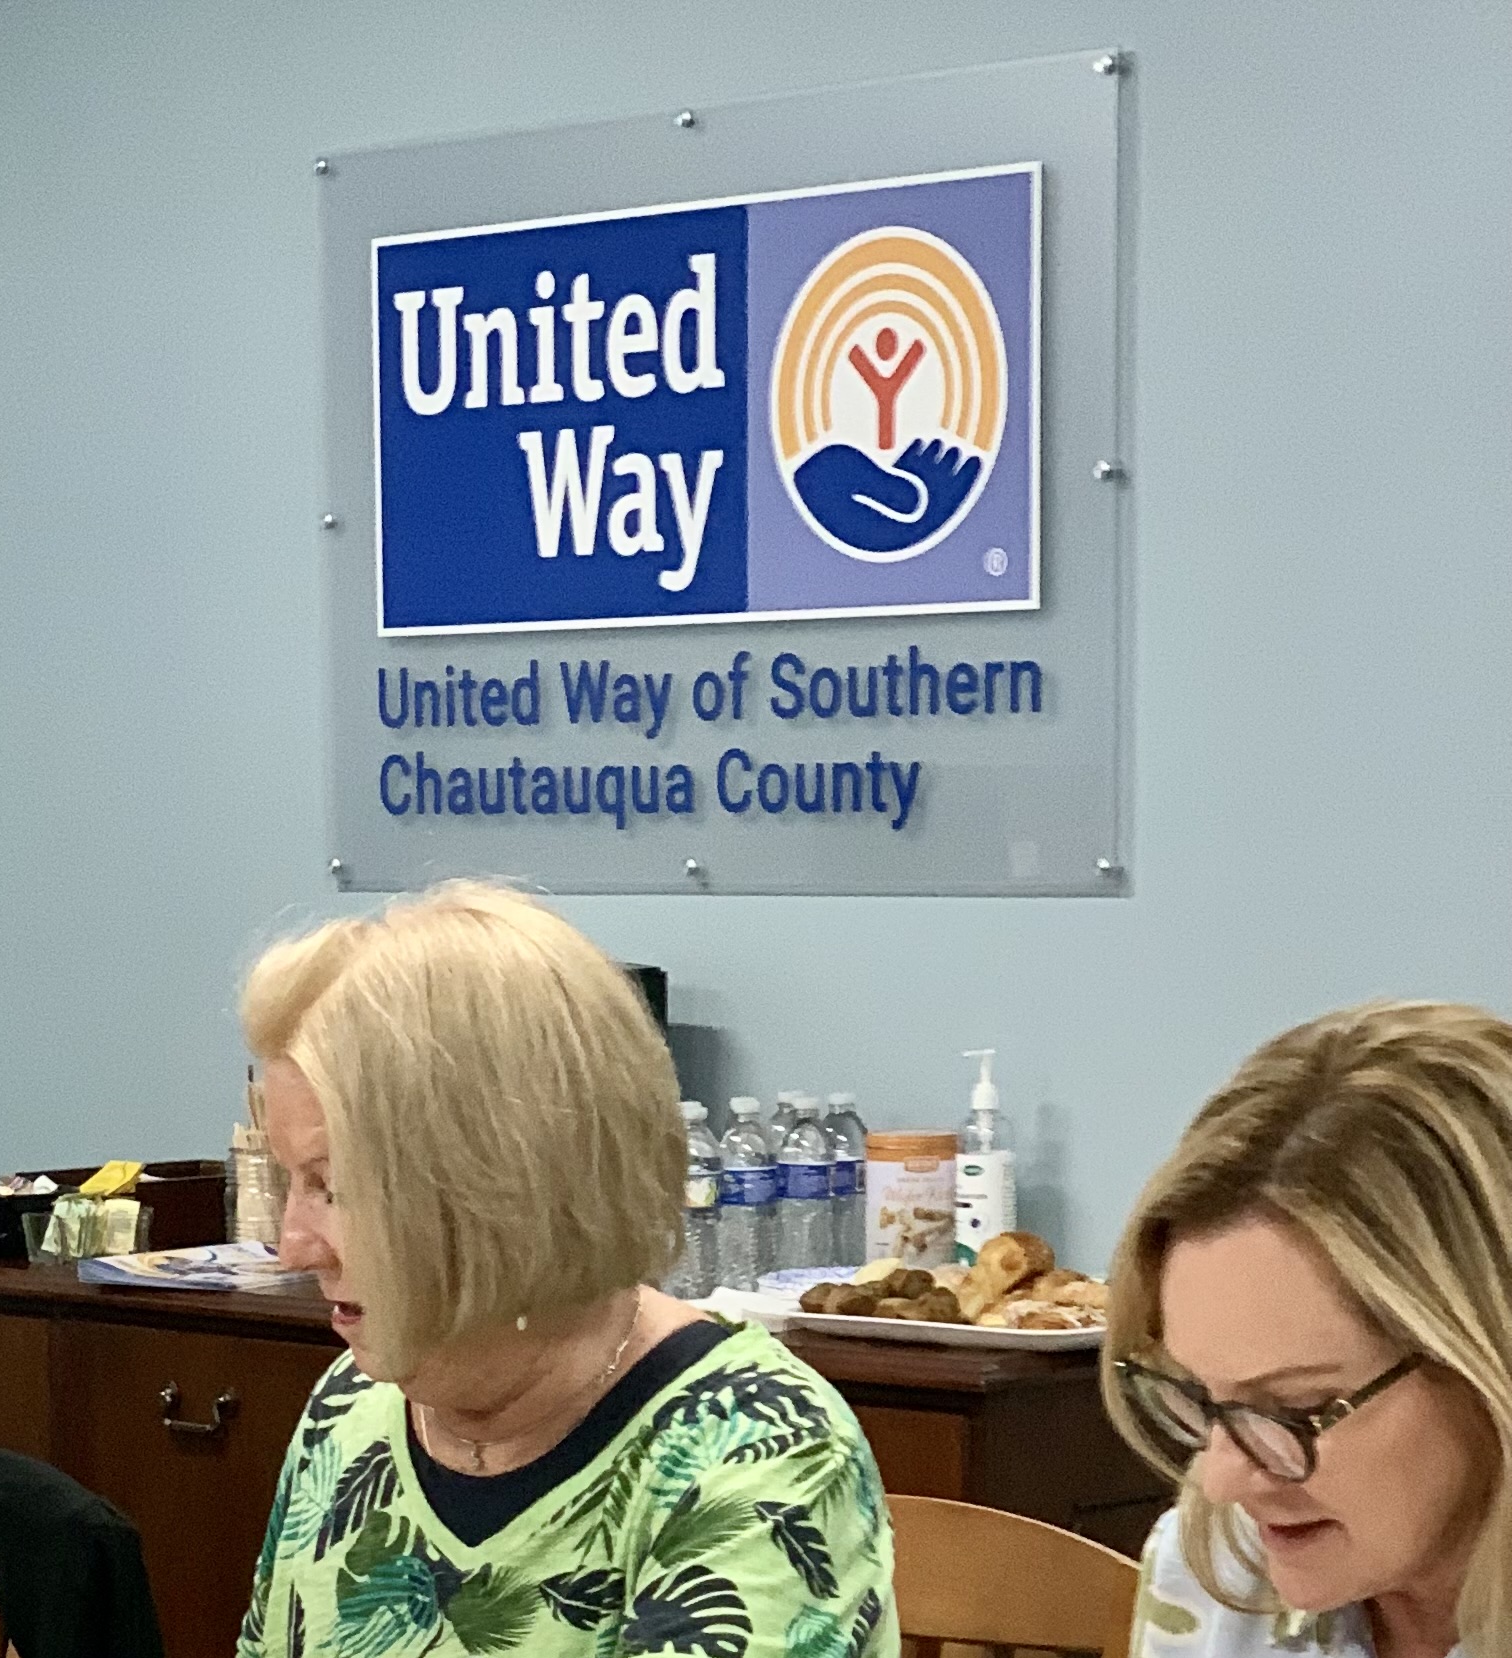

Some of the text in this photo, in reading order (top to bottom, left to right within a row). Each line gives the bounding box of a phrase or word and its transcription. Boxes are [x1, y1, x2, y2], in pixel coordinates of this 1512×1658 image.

[392, 252, 725, 415] United
[518, 424, 724, 592] Way
[378, 646, 1043, 739] United Way of Southern
[379, 749, 922, 829] Chautauqua County
